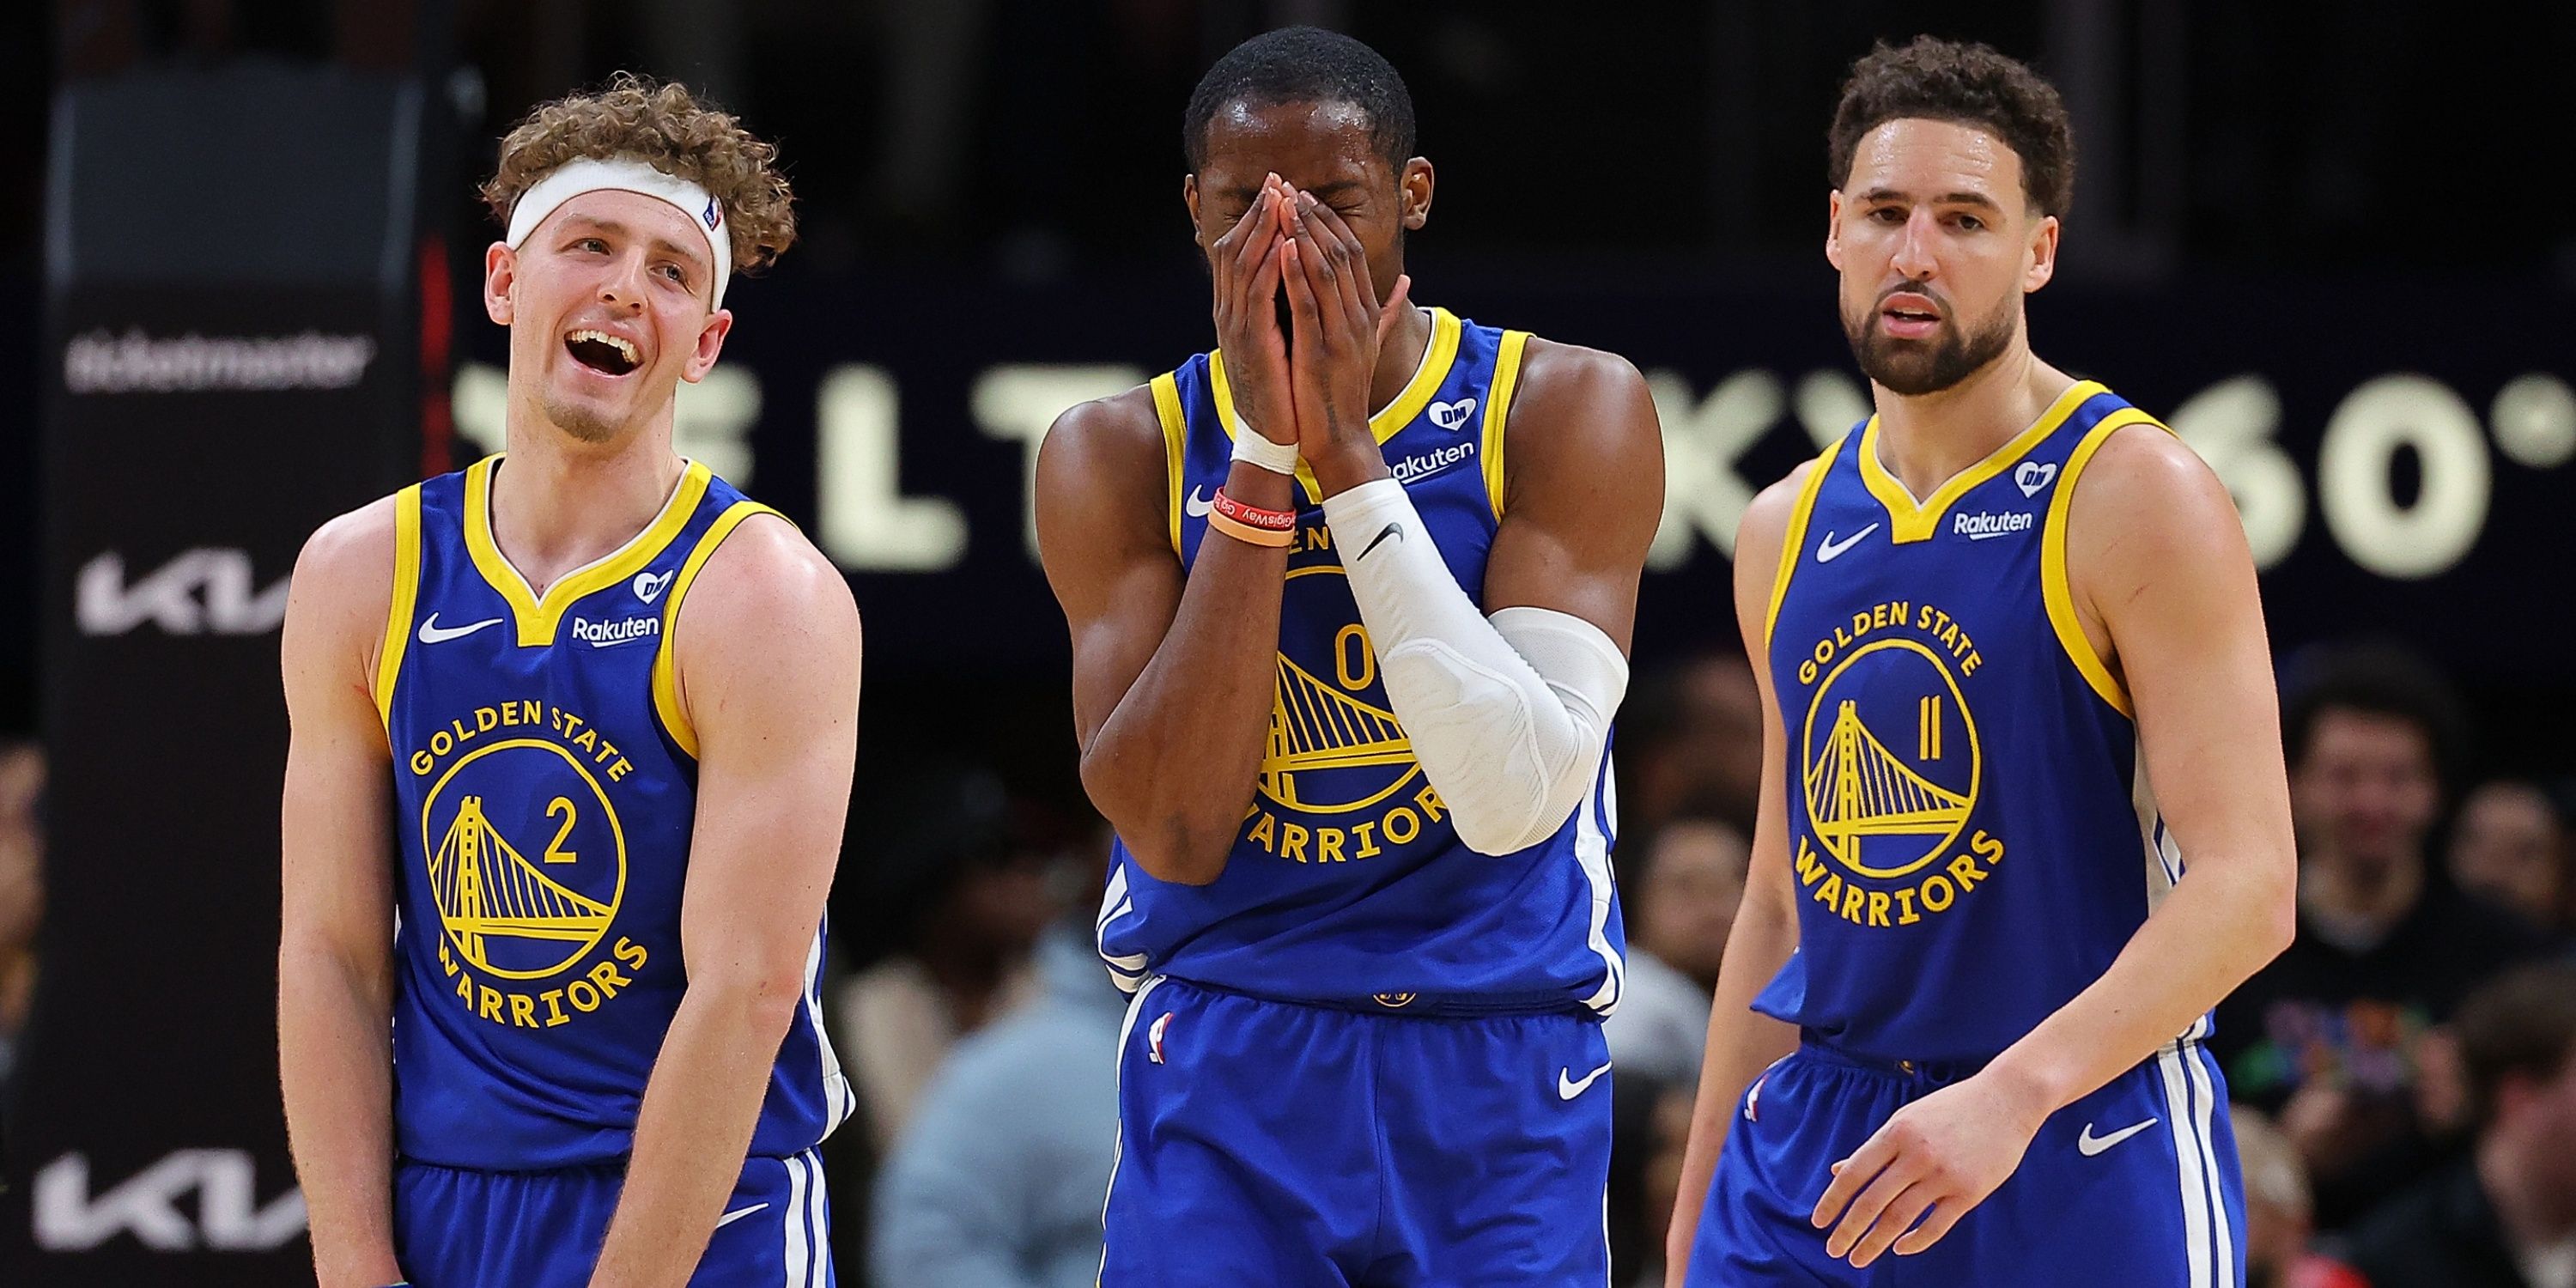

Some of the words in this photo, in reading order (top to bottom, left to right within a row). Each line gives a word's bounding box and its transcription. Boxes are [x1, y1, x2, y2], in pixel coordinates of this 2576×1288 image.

[1441, 406, 1467, 425] DM
[1384, 441, 1474, 479] akuten
[2022, 470, 2048, 486] DM
[1953, 511, 2032, 534] Rakuten
[572, 617, 659, 641] Rakuten
[1334, 623, 1375, 690] 0
[1798, 601, 1909, 685] GOLDEN
[1917, 605, 1983, 677] STATE
[410, 700, 542, 775] GOLDEN
[550, 707, 634, 782] STATE
[1919, 695, 1941, 761] 11
[544, 796, 577, 864] 2
[1245, 785, 1449, 864] ARRIOR
[1795, 829, 2006, 927] WARRIORS
[438, 930, 648, 1029] WARRIORS
